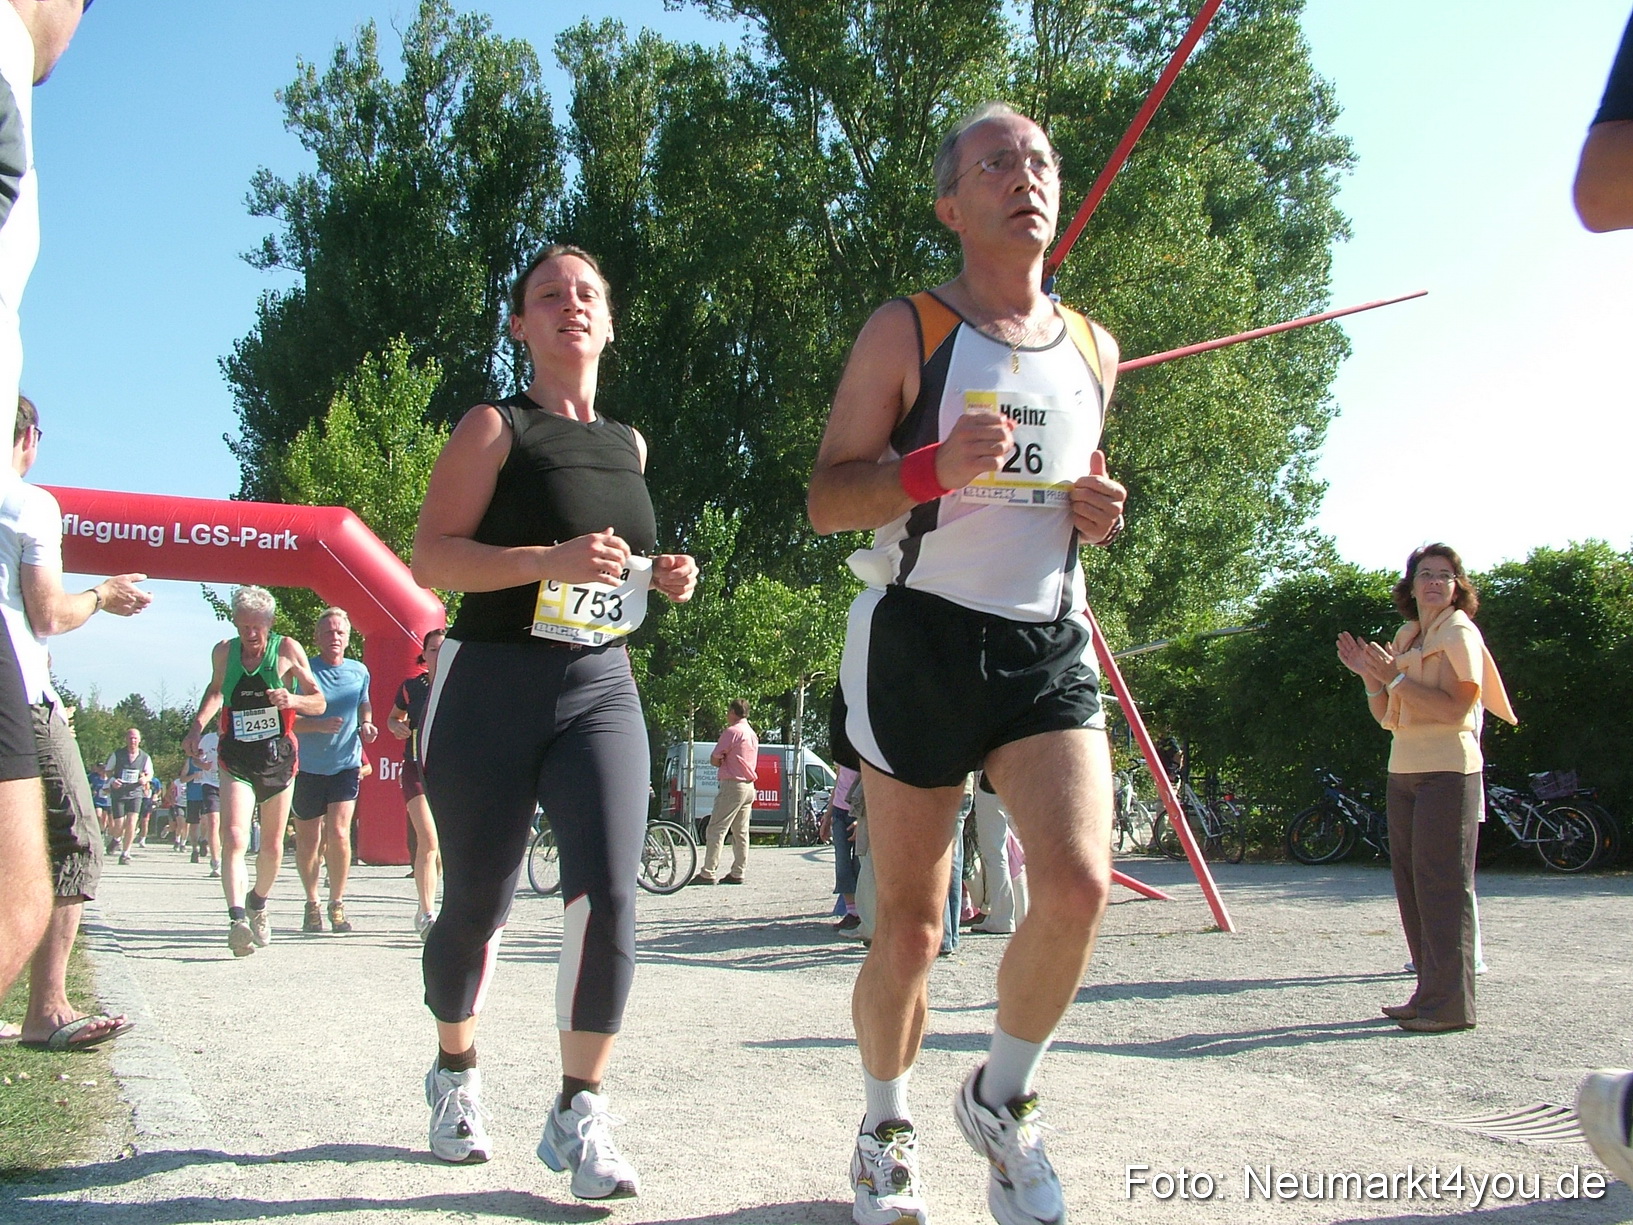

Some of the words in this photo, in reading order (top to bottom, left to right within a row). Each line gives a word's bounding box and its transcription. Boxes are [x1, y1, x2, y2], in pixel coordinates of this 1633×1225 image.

[1000, 404, 1047, 426] Heinz
[1001, 442, 1043, 474] 26
[173, 522, 299, 550] LGS-Park
[572, 587, 623, 621] 753
[535, 622, 579, 637] BOCK
[245, 718, 276, 732] 2433
